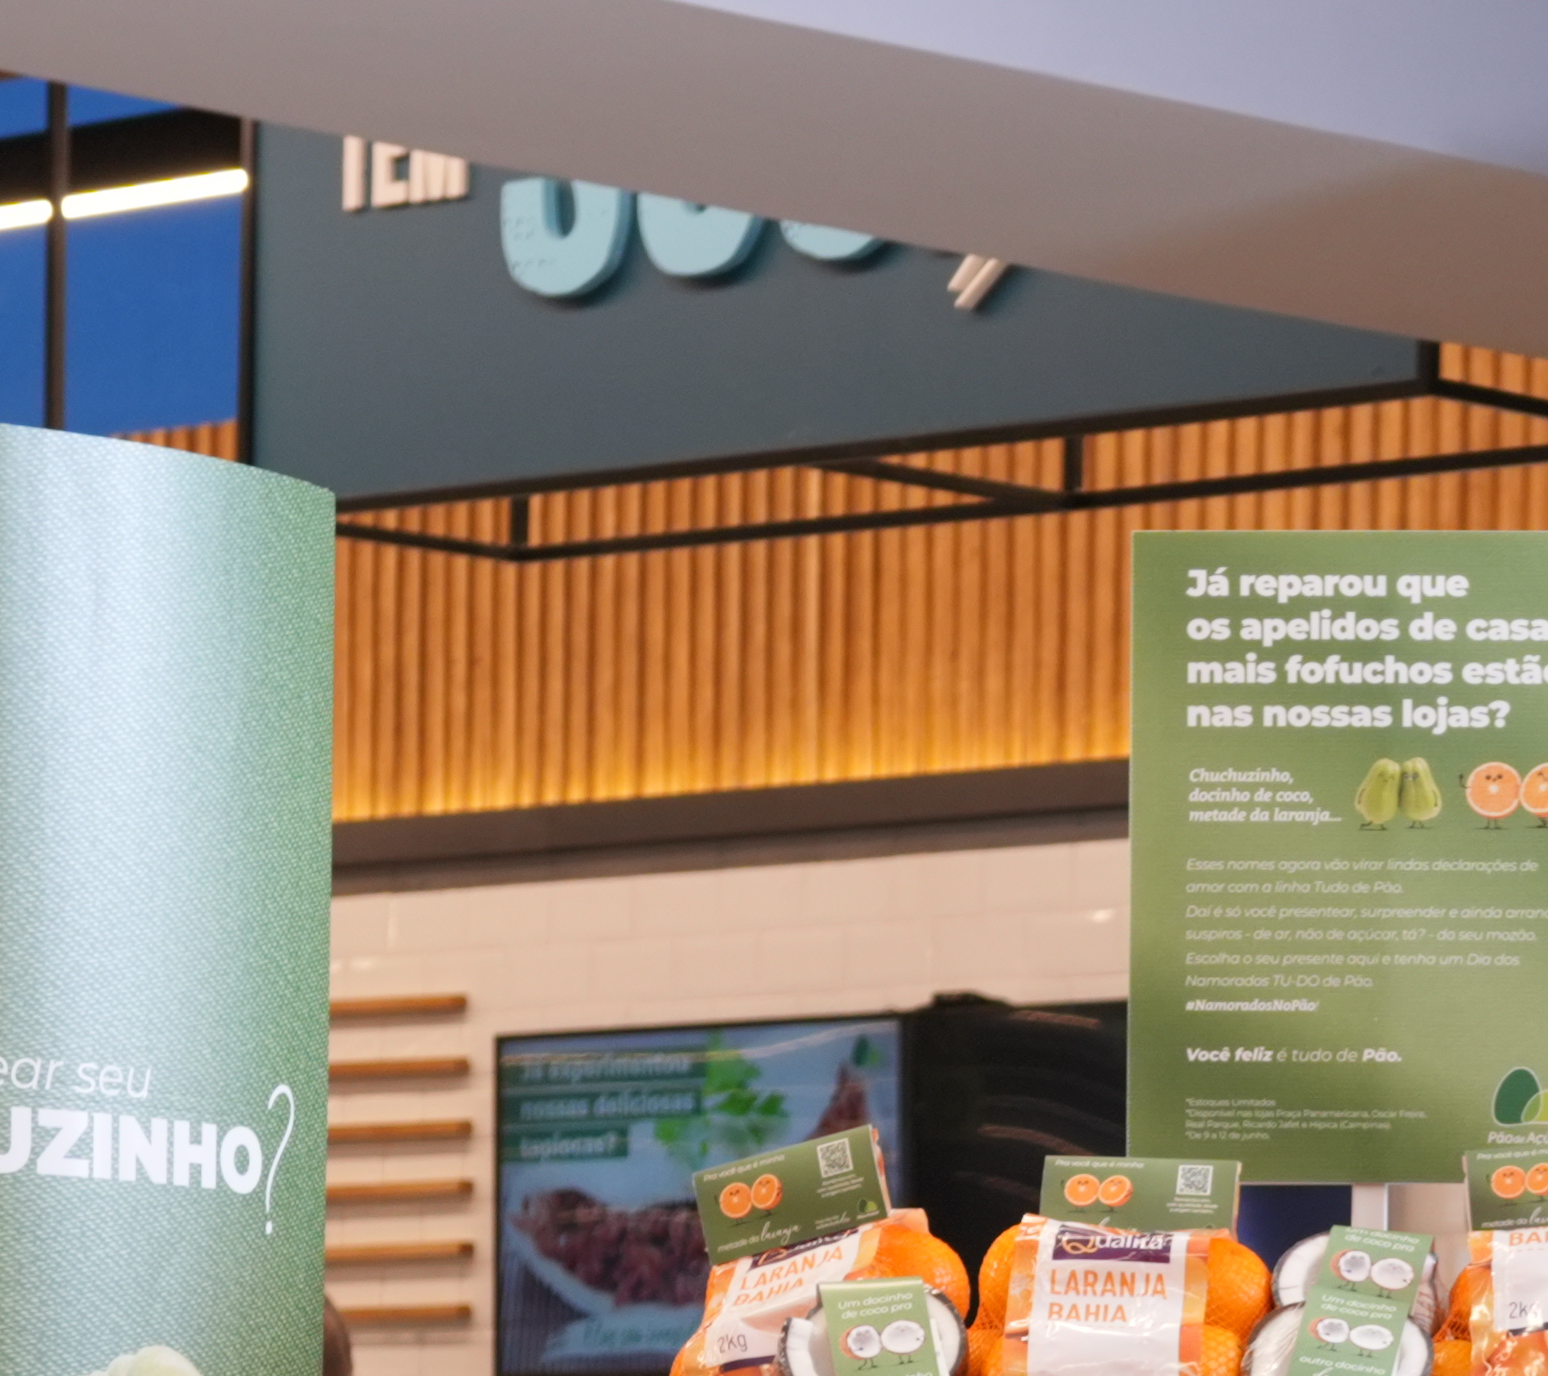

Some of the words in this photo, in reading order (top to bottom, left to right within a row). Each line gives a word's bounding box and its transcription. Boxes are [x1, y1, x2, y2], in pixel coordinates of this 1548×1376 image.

[1185, 566, 1230, 599] Já
[1239, 571, 1387, 604] reparou
[1396, 573, 1470, 604] que
[1186, 615, 1231, 641] os
[1240, 608, 1400, 647] apelidos
[1408, 611, 1457, 641] de
[1186, 652, 1277, 685] mais
[1285, 654, 1453, 685] fofuchos
[1186, 703, 1253, 728] nas
[1263, 703, 1393, 728] nossas
[1401, 696, 1511, 735] lojas?
[75, 1061, 152, 1099] seu
[1049, 1269, 1167, 1299] LARANJA
[1048, 1303, 1127, 1322] BAHIA
